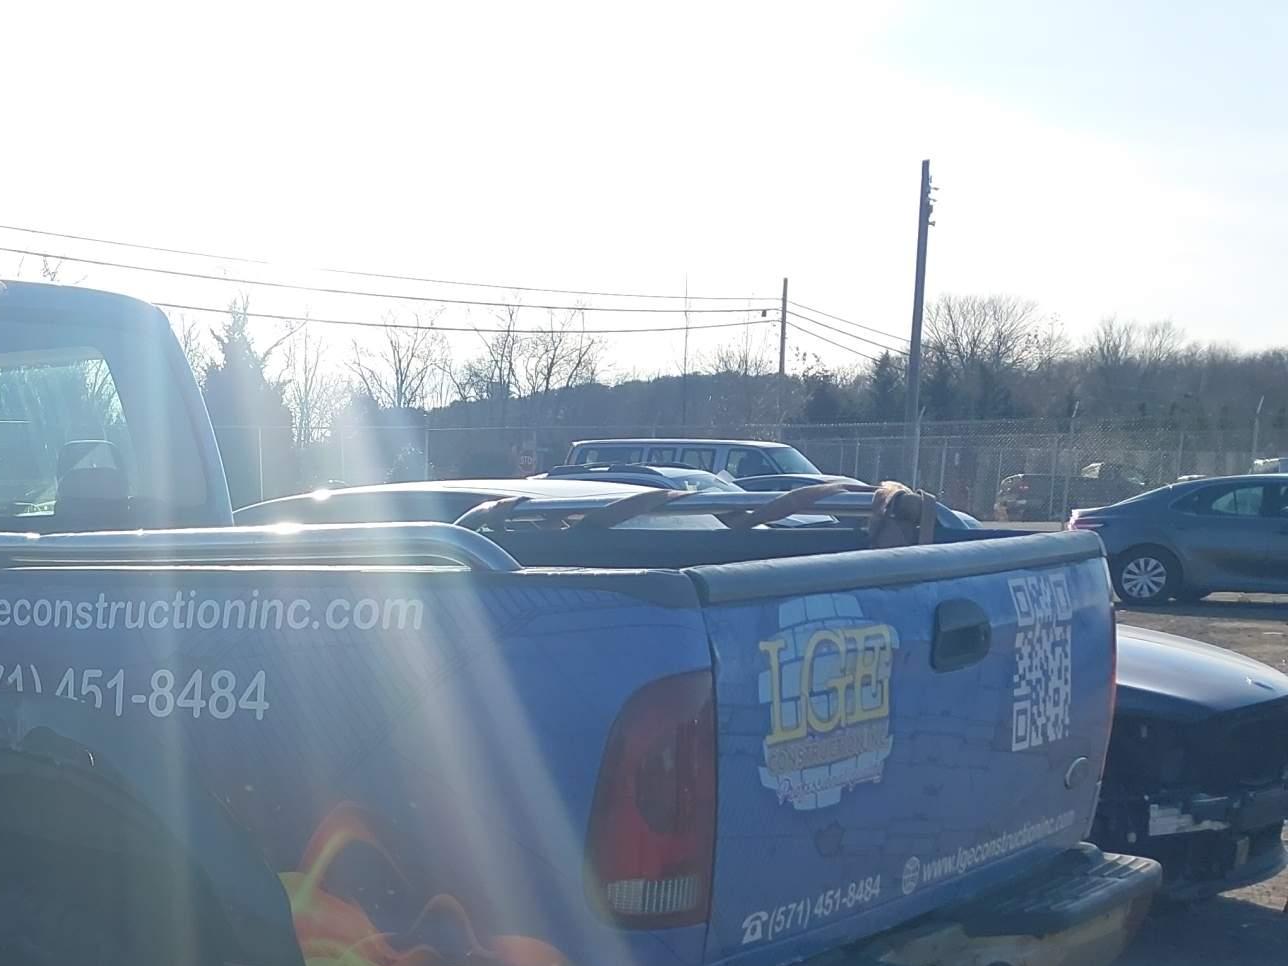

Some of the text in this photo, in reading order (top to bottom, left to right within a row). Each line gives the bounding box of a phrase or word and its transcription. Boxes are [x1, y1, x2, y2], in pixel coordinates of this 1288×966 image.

[55, 667, 270, 721] 451-8484
[759, 625, 892, 745] LGE
[768, 874, 881, 940] (571) 451-8484
